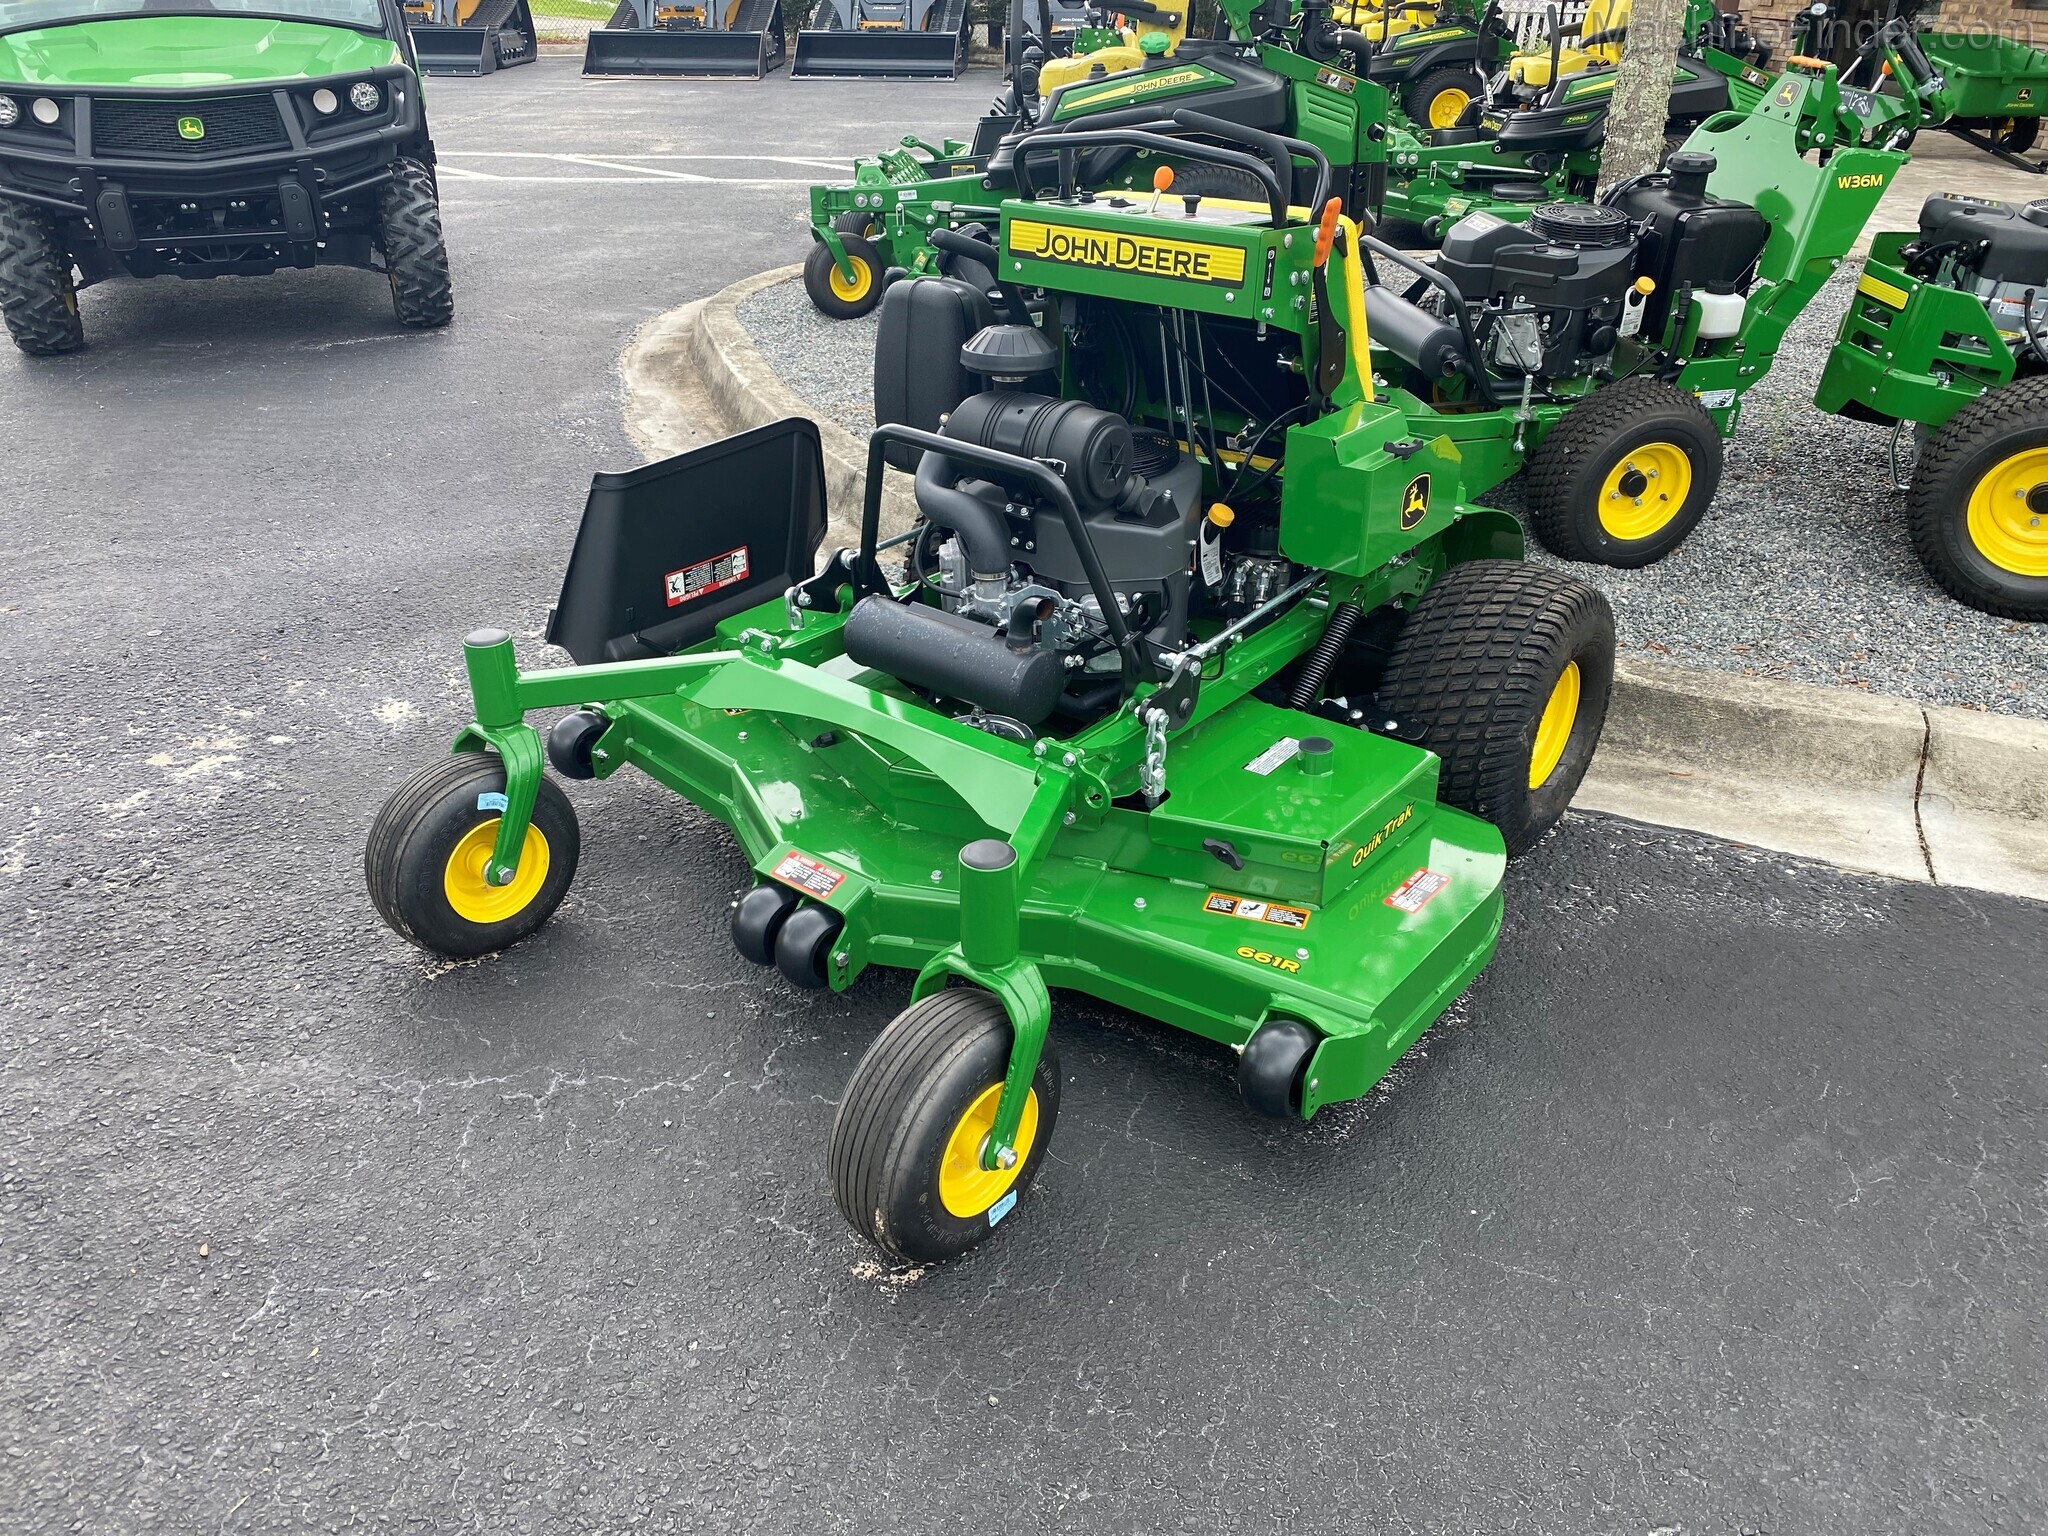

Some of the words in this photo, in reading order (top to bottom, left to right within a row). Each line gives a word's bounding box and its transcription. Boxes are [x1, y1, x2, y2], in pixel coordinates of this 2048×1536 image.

[1130, 81, 1158, 94] JOHN
[1159, 73, 1192, 87] DEERE
[1837, 173, 1884, 189] W36M
[1035, 227, 1109, 265] JOHN
[1115, 236, 1212, 279] DEERE
[1236, 946, 1302, 975] 661R
